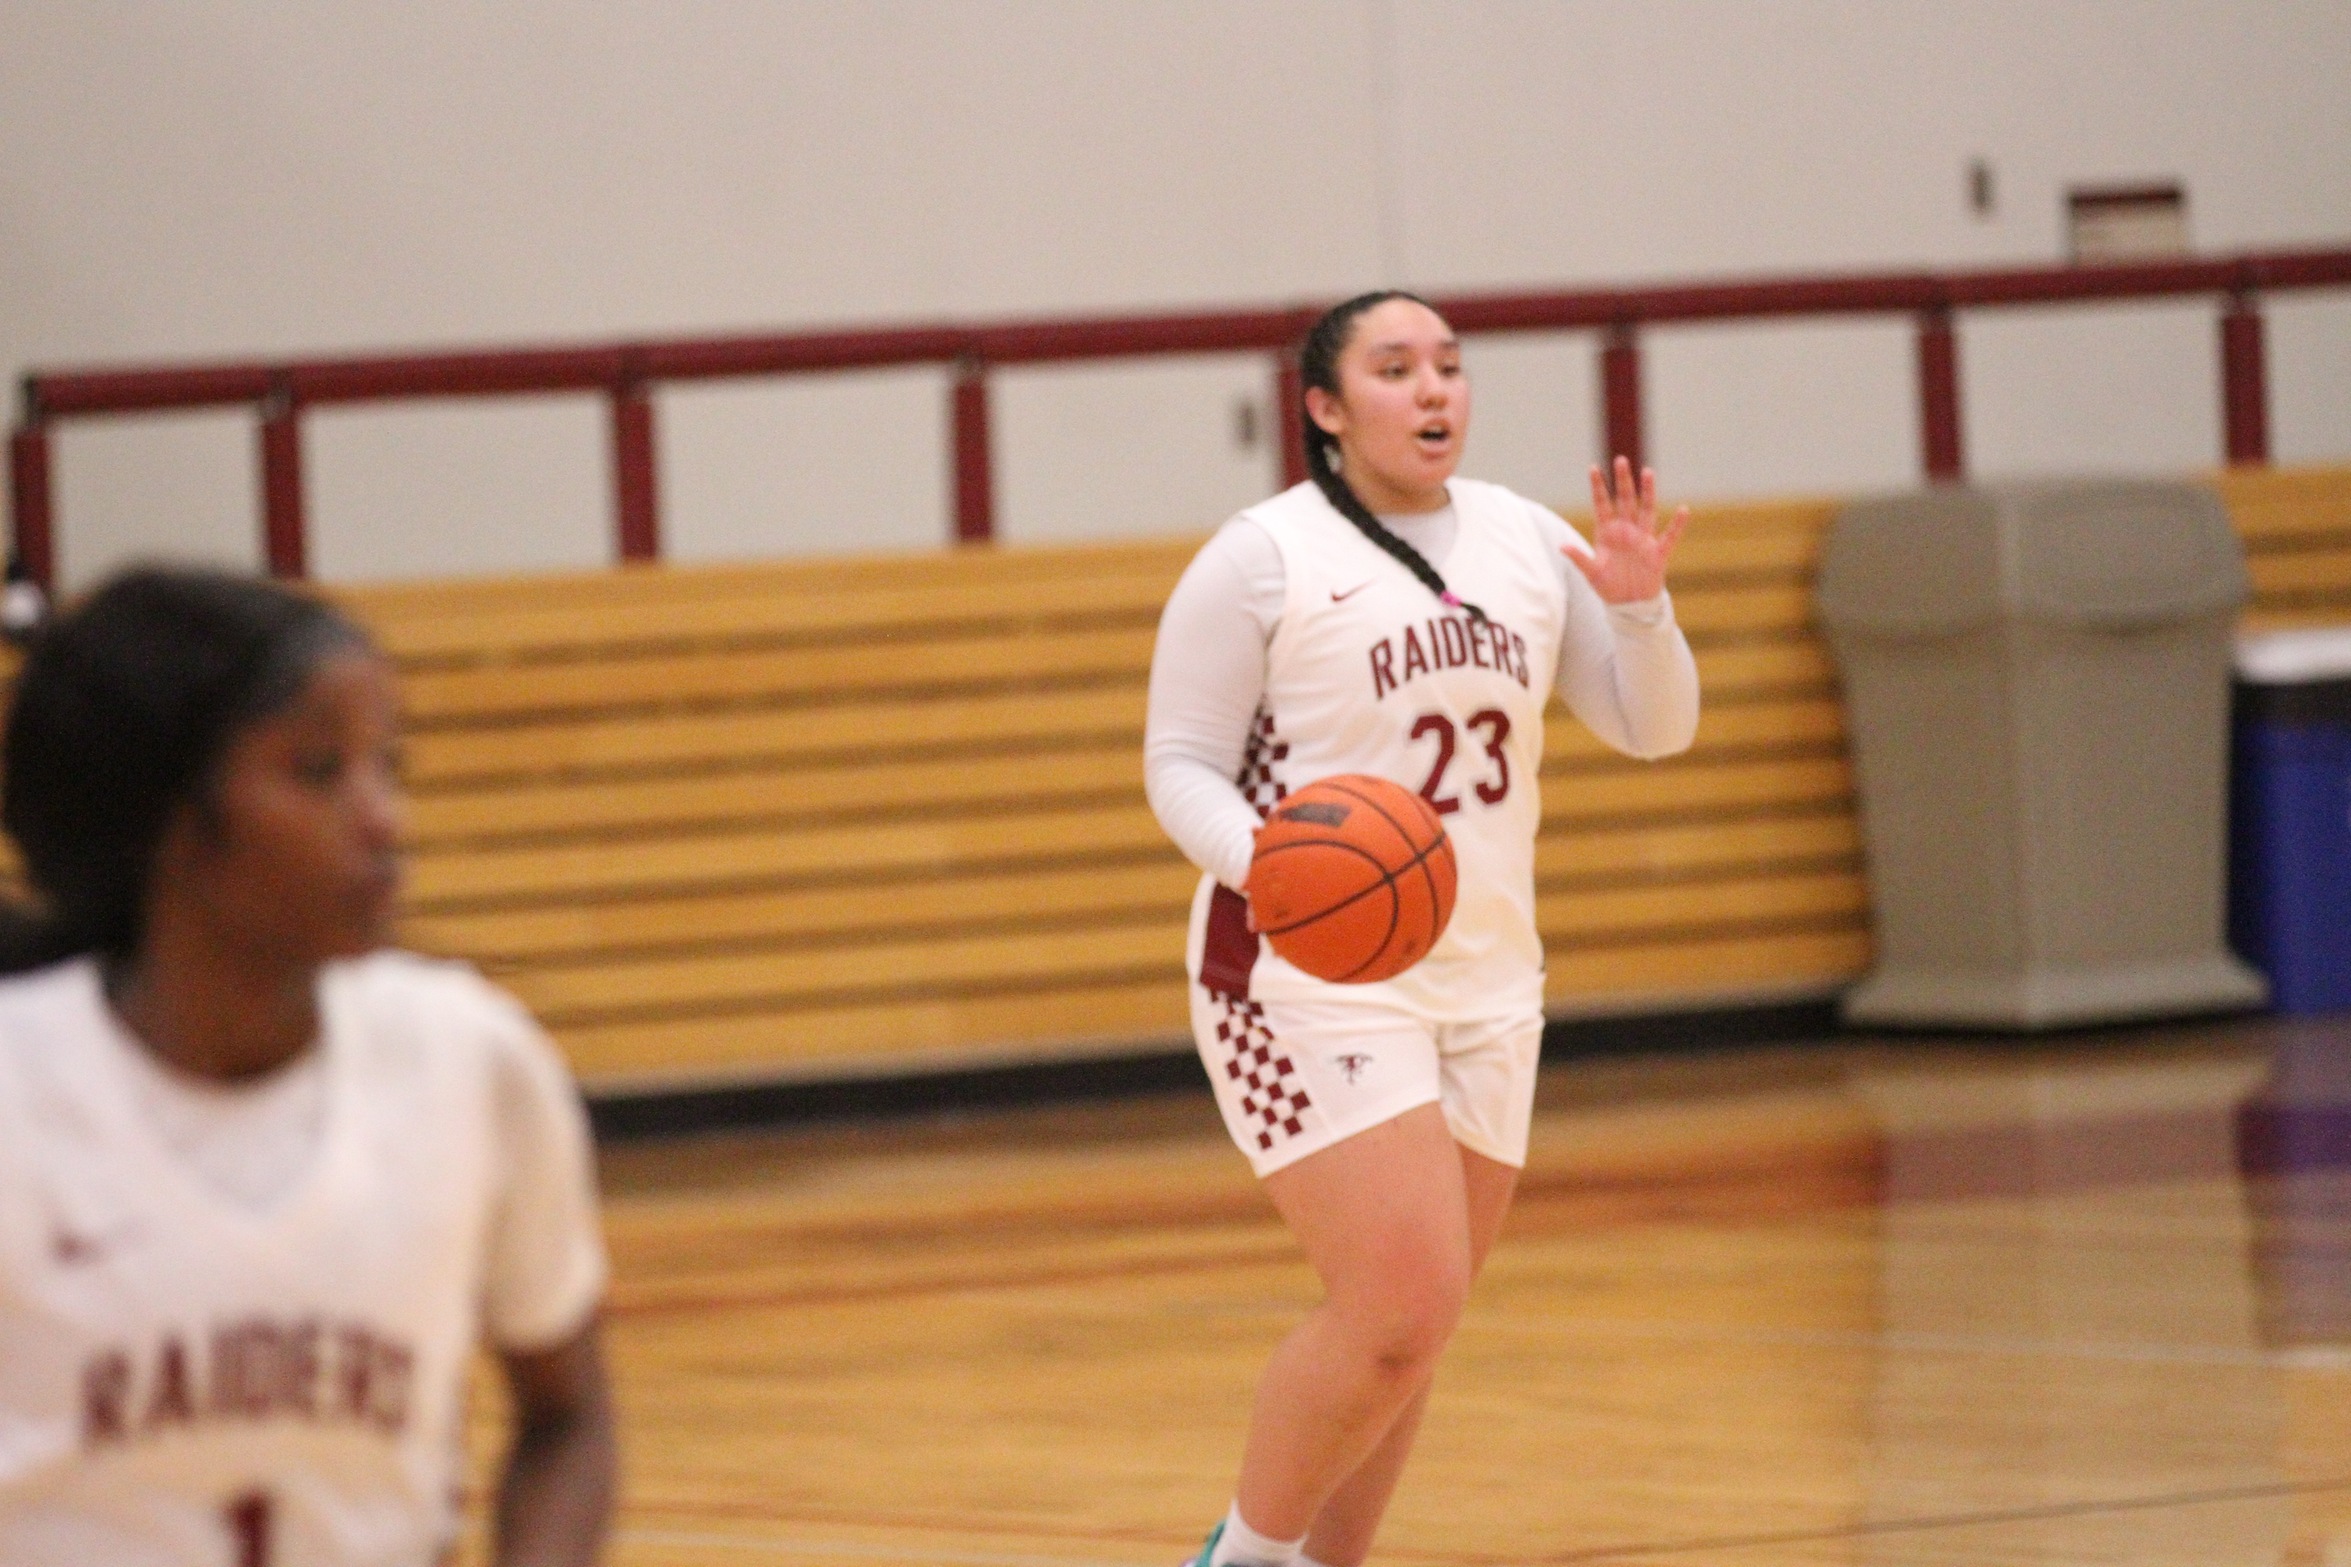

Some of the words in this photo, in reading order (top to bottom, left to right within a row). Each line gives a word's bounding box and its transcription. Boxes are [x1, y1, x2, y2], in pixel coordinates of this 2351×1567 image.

[1369, 615, 1529, 701] RAIDERS
[1410, 709, 1511, 816] 23
[80, 1316, 414, 1455] RAIDERS
